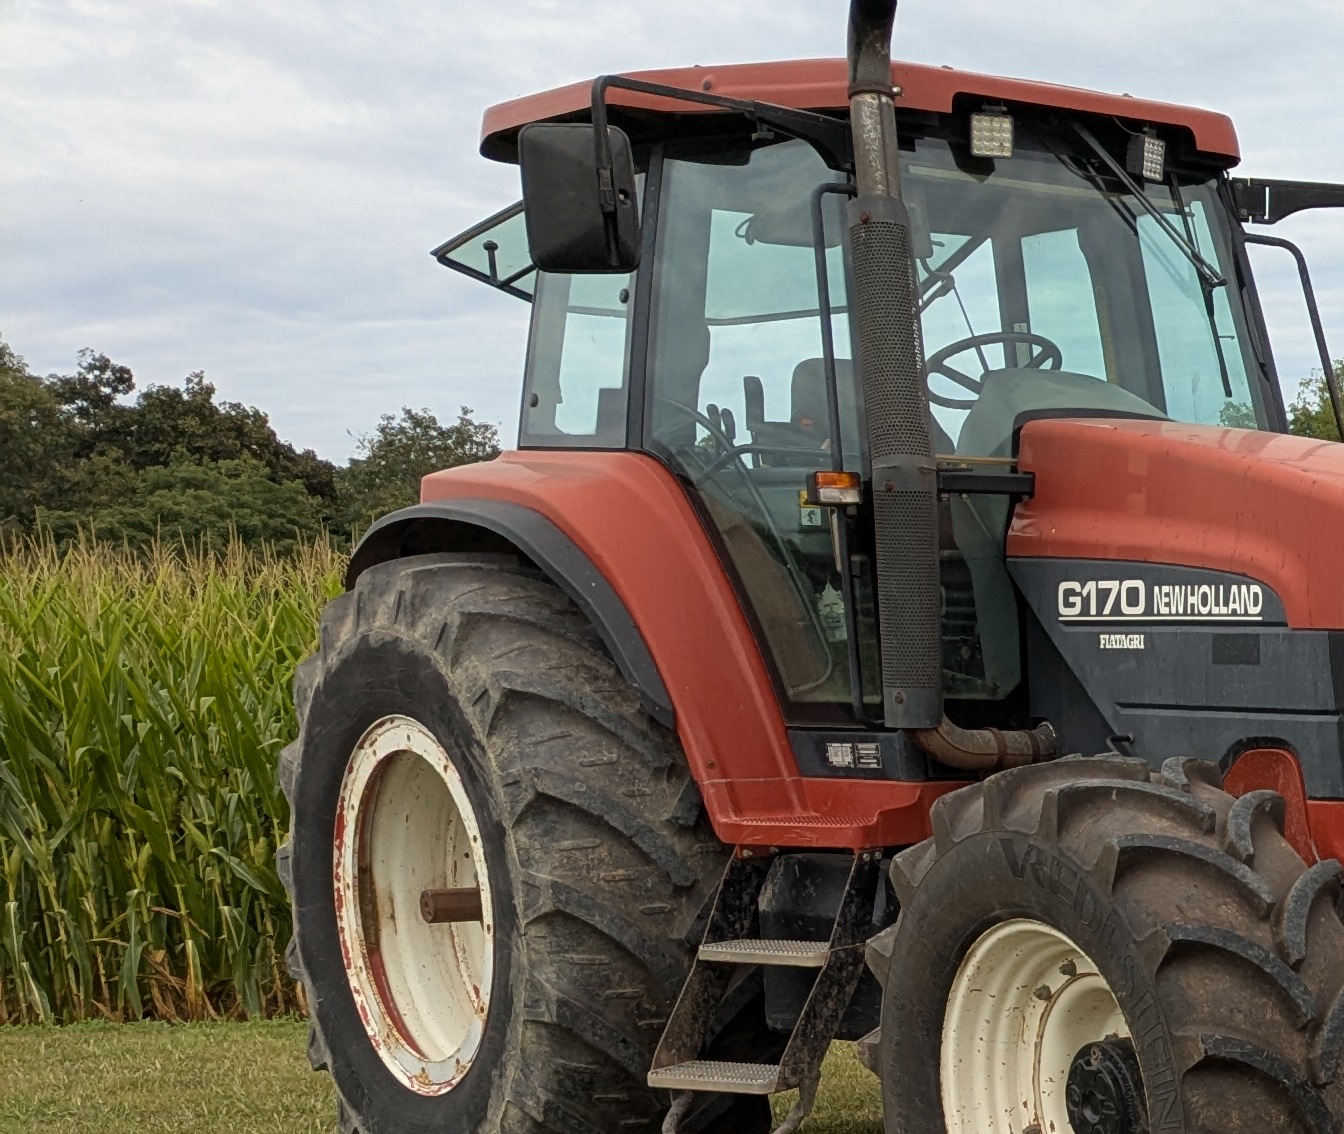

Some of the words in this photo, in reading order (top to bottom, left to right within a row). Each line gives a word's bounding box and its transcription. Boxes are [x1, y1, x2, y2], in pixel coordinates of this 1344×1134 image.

[1058, 579, 1145, 616] G170
[1153, 584, 1186, 615] NEW
[1187, 584, 1263, 615] HOLLAND
[1099, 634, 1145, 649] FIATAGRI
